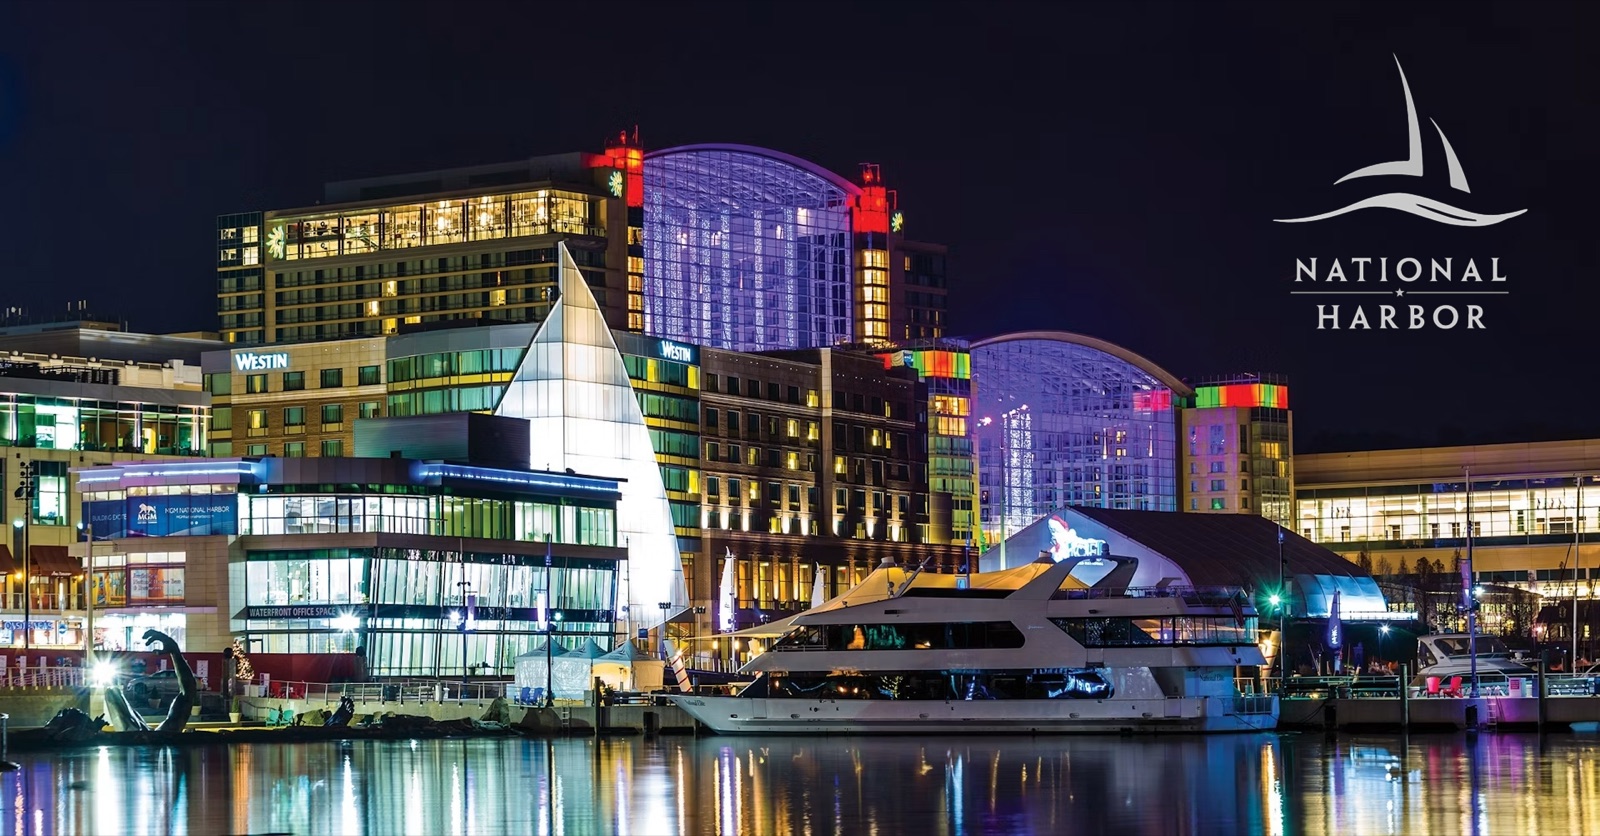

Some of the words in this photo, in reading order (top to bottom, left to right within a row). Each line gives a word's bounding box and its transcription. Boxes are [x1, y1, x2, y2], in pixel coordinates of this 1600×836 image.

[235, 353, 288, 371] WESTIN
[137, 513, 157, 521] MGM
[249, 607, 291, 617] WATERFRONT
[292, 607, 314, 616] OFFICE
[315, 607, 335, 616] SPACE
